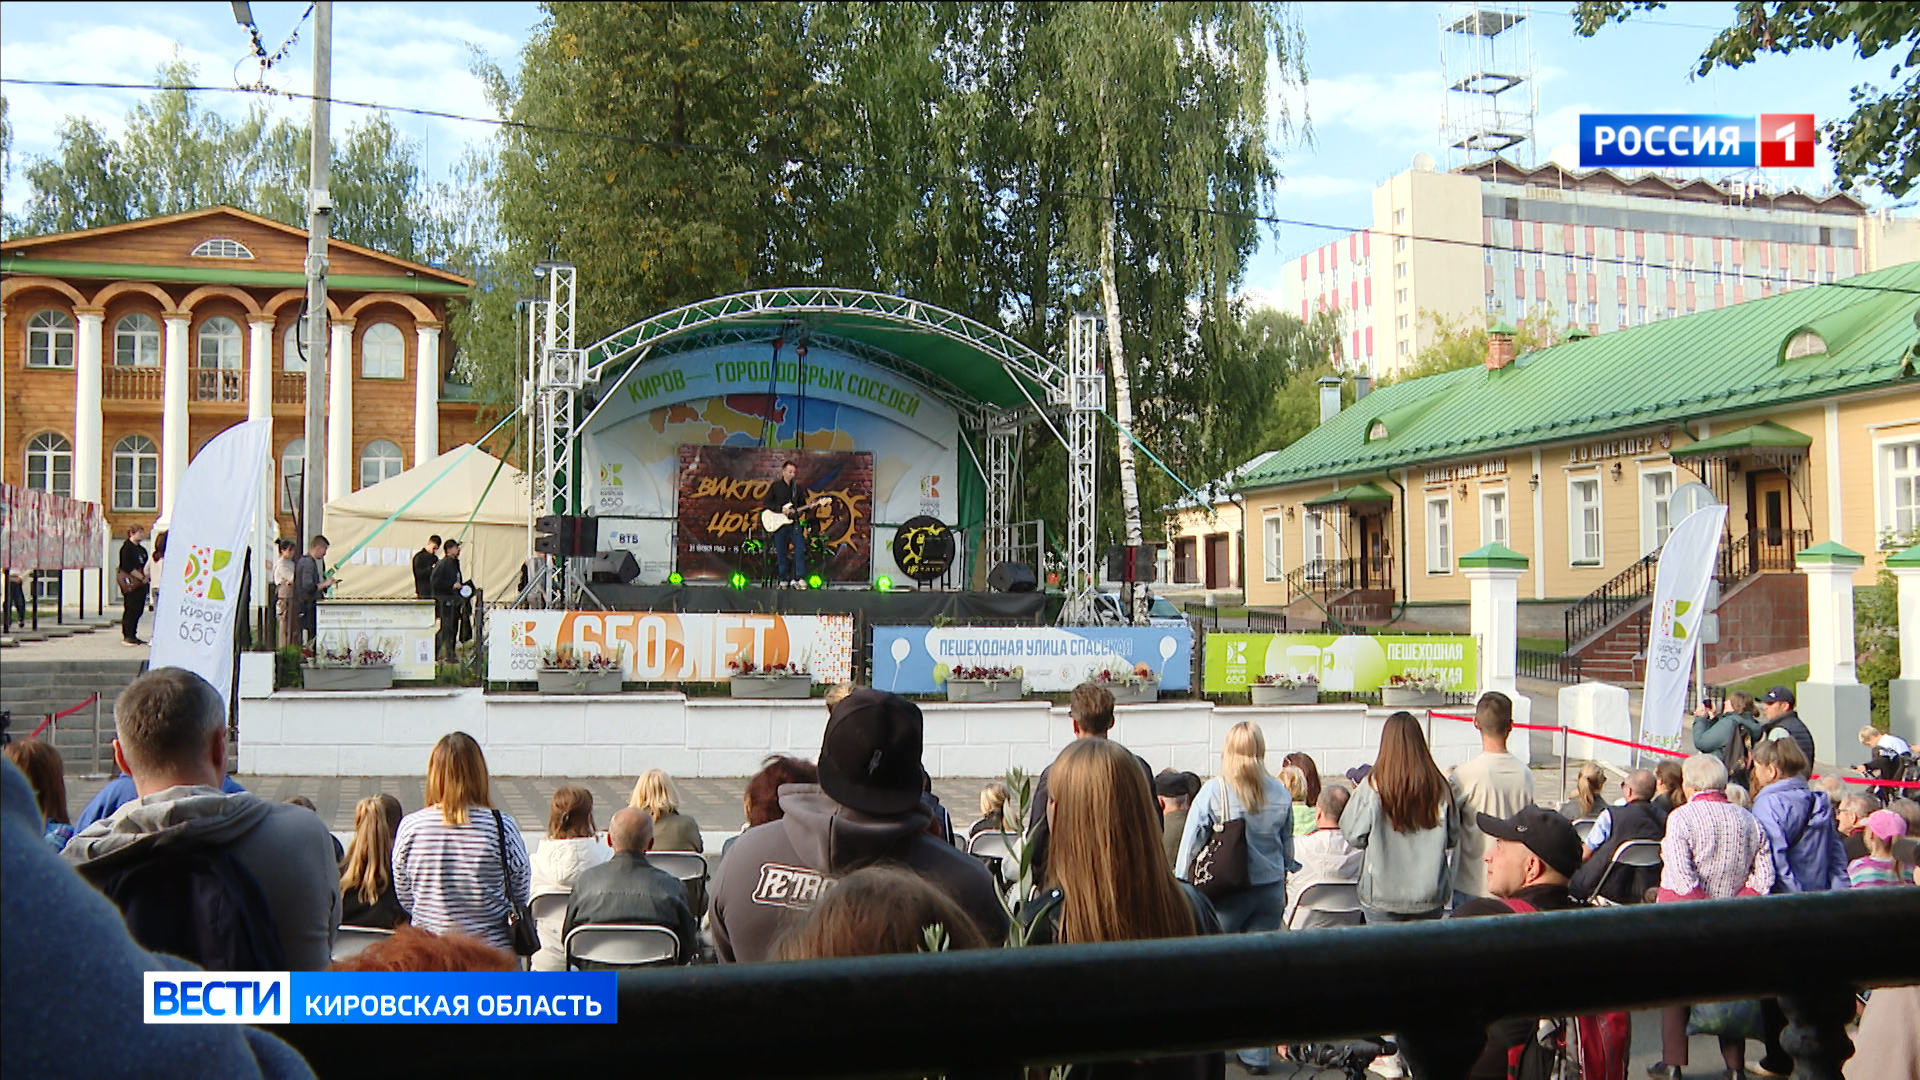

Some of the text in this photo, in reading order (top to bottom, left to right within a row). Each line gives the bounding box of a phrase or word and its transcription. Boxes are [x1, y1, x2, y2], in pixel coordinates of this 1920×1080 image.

[626, 368, 686, 404] КИРОВ
[714, 360, 770, 384] ГОРОД
[775, 361, 846, 392] ДОБРЫХ
[846, 373, 921, 418] СОСЕДЕЙ
[690, 476, 773, 500] ВИКТО
[706, 506, 764, 538] ЦОЙ
[619, 533, 639, 545] ВТБ
[179, 621, 217, 646] 650
[573, 614, 775, 679] 650 ЛЕТ
[939, 637, 1134, 657] ПЕШЕХОДНАЯ УЛИЦА СПАССКАЯ
[1387, 643, 1463, 660] ПЕШЕХОДНАЯ
